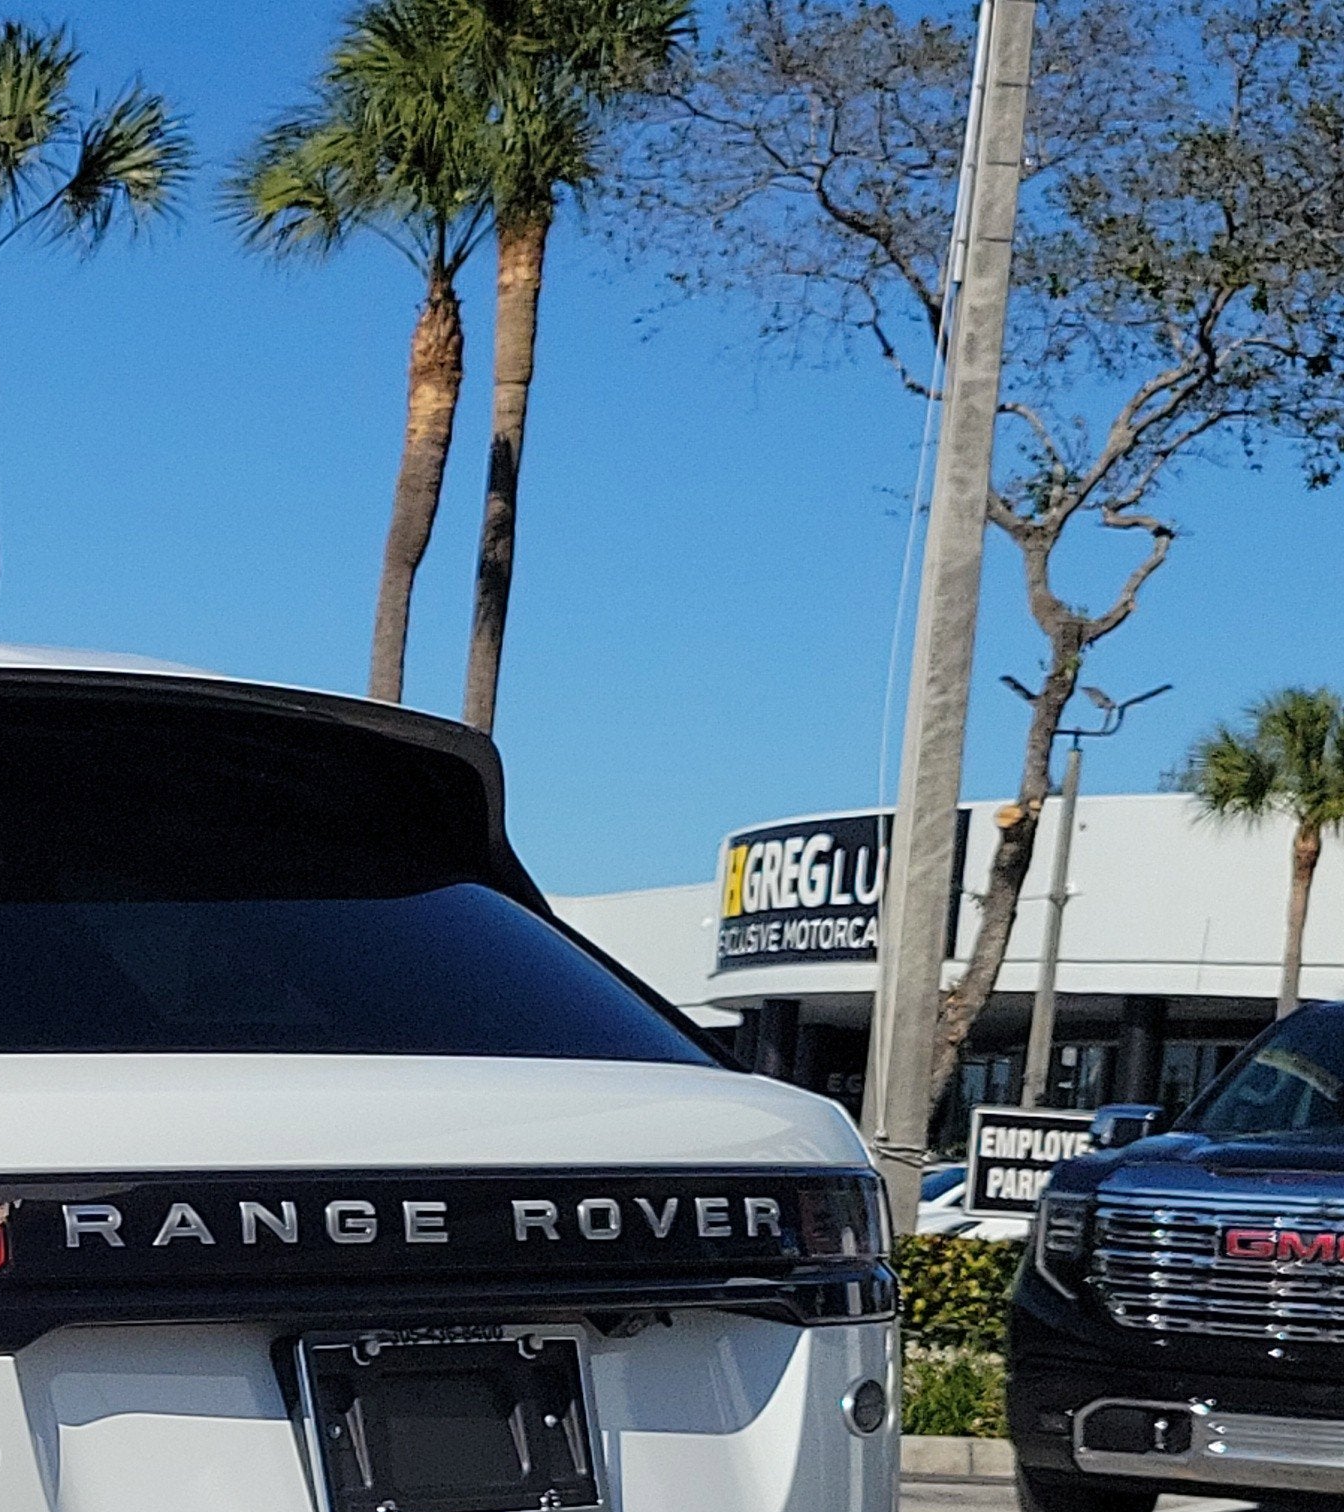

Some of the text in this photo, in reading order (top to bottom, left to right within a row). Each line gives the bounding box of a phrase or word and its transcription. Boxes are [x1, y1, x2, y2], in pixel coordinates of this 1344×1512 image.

[62, 1197, 782, 1248] RANGE ROVER
[1225, 1228, 1344, 1261] GM
